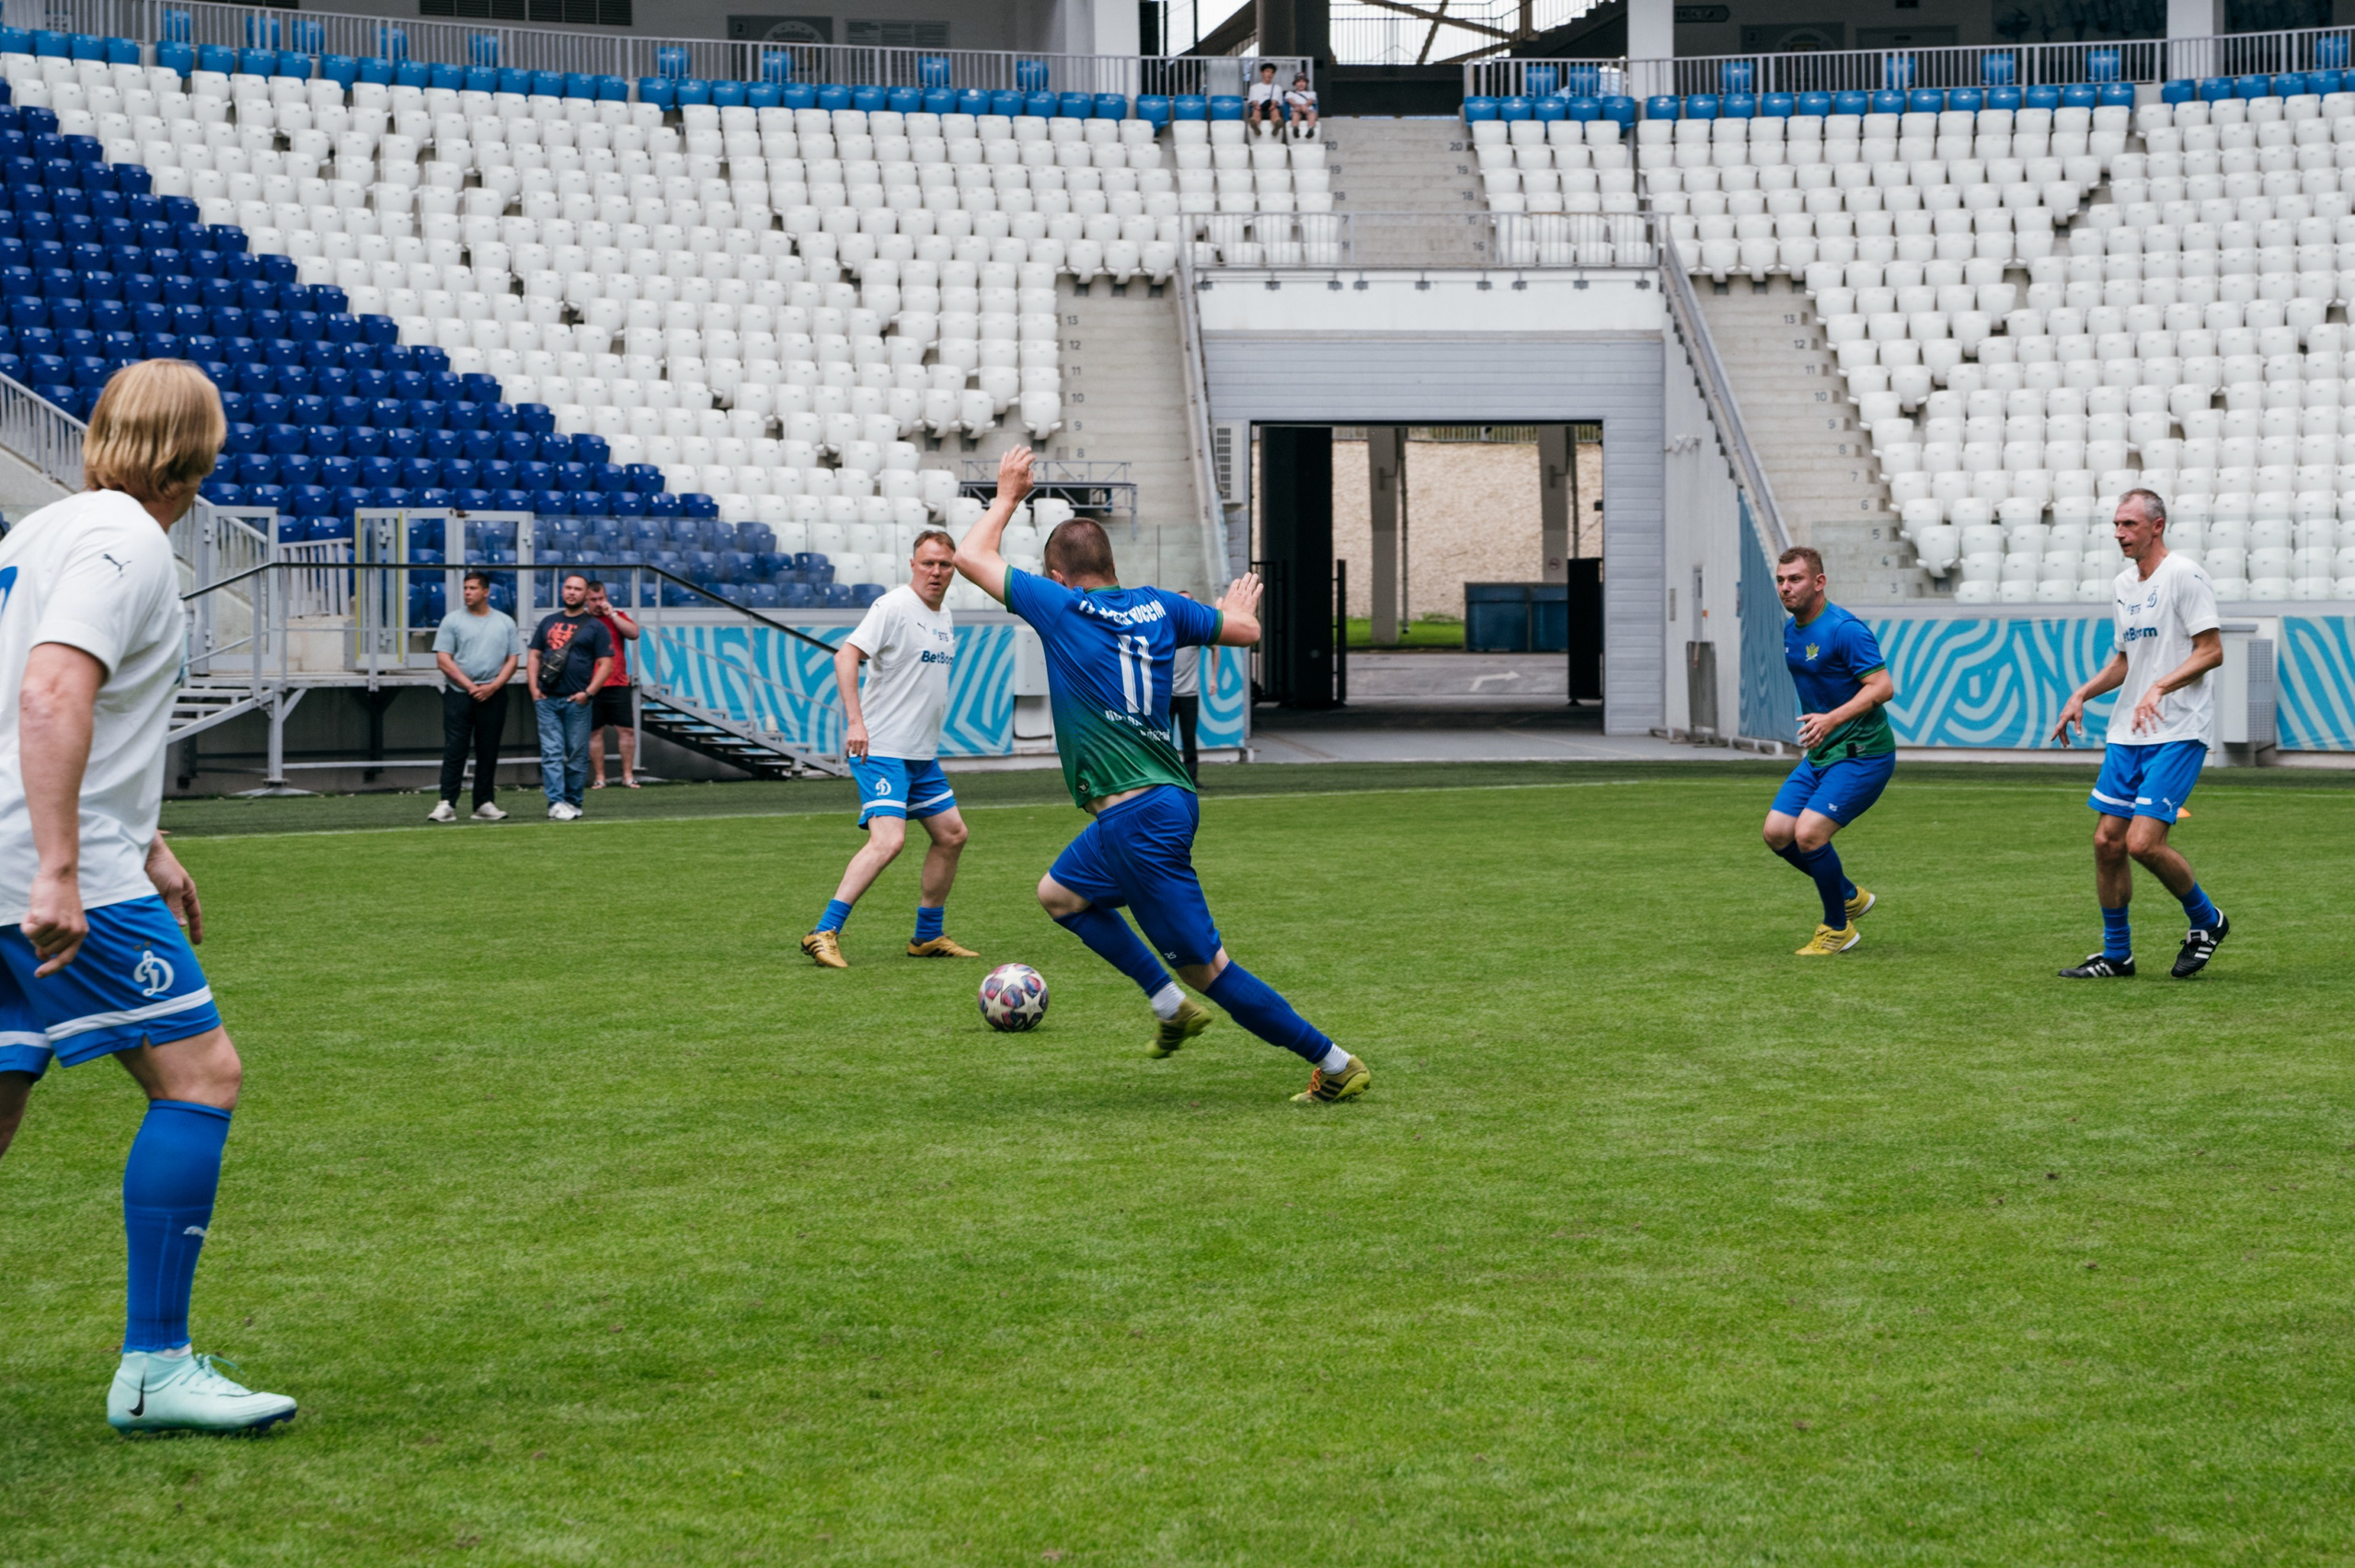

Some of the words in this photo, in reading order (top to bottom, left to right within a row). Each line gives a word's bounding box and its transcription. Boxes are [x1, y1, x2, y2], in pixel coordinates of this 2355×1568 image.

[1449, 142, 1463, 151] 20
[1330, 166, 1341, 174] 19
[1456, 165, 1468, 175] 19
[1334, 192, 1346, 200] 18
[1462, 191, 1474, 200] 18
[1473, 241, 1485, 251] 16
[1067, 315, 1078, 326] 13
[1783, 315, 1796, 325] 13
[1069, 340, 1081, 350] 12
[1794, 339, 1806, 349] 12
[1071, 367, 1081, 375] 11
[1805, 365, 1816, 375] 11
[1072, 394, 1085, 403] 10
[1814, 392, 1828, 402] 10
[1074, 421, 1083, 431] 9
[1828, 419, 1836, 429] 9
[1076, 448, 1085, 458] 8
[1839, 444, 1846, 454] 8
[1851, 472, 1858, 482] 7
[1861, 499, 1868, 509] 6
[1872, 529, 1880, 540] 5
[1881, 556, 1890, 567] 4
[1890, 583, 1899, 593] 3
[1116, 634, 1154, 716] 11
